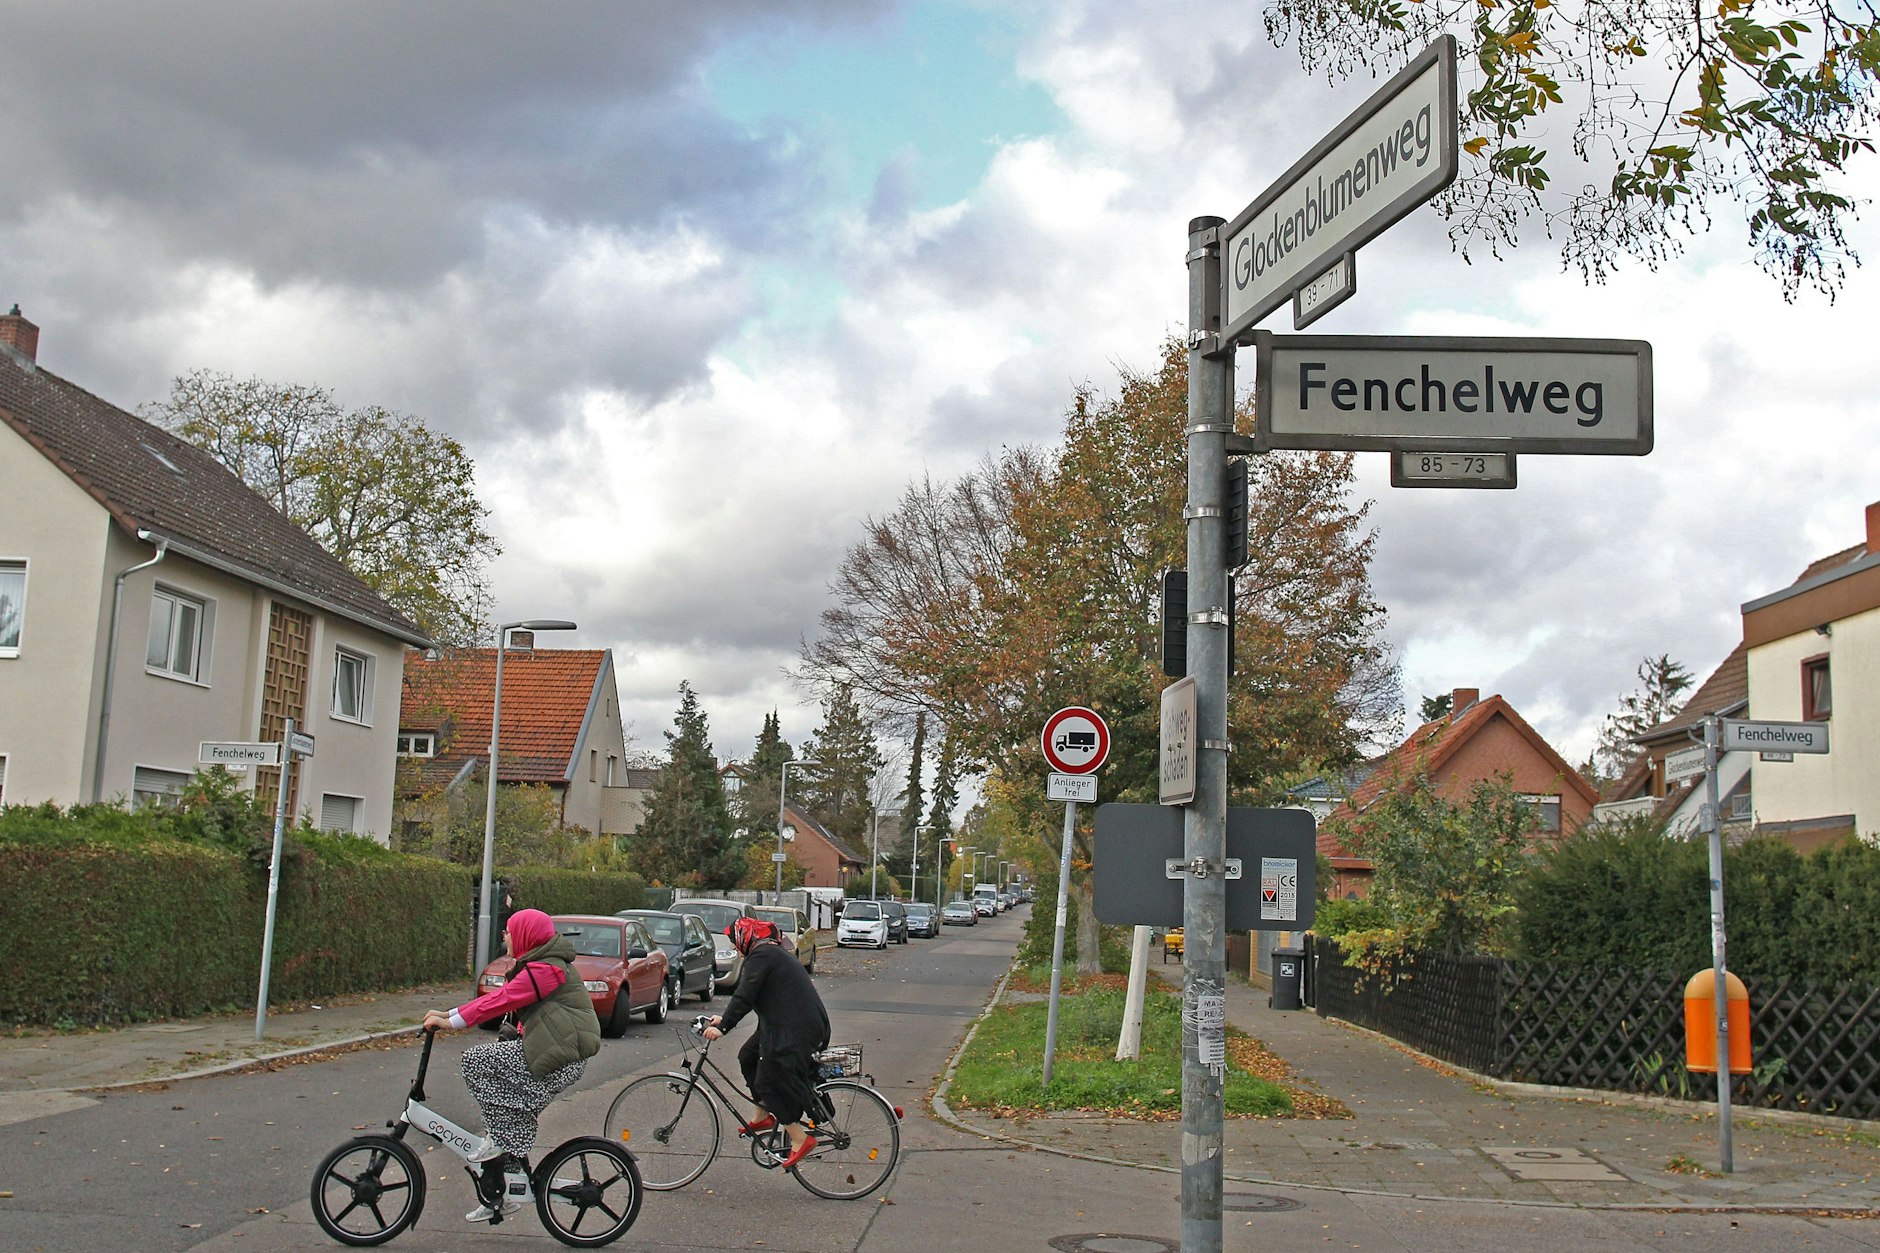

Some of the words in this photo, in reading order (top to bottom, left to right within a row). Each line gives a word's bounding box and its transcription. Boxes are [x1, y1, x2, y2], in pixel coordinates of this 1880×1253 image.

[1234, 103, 1431, 291] Glockenblumenweg
[1299, 362, 1604, 428] Fenchelweg
[1738, 726, 1813, 746] Fenchelweg
[212, 747, 265, 760] Fenchelweg
[1054, 778, 1091, 789] Anlieger
[1064, 787, 1080, 796] frei
